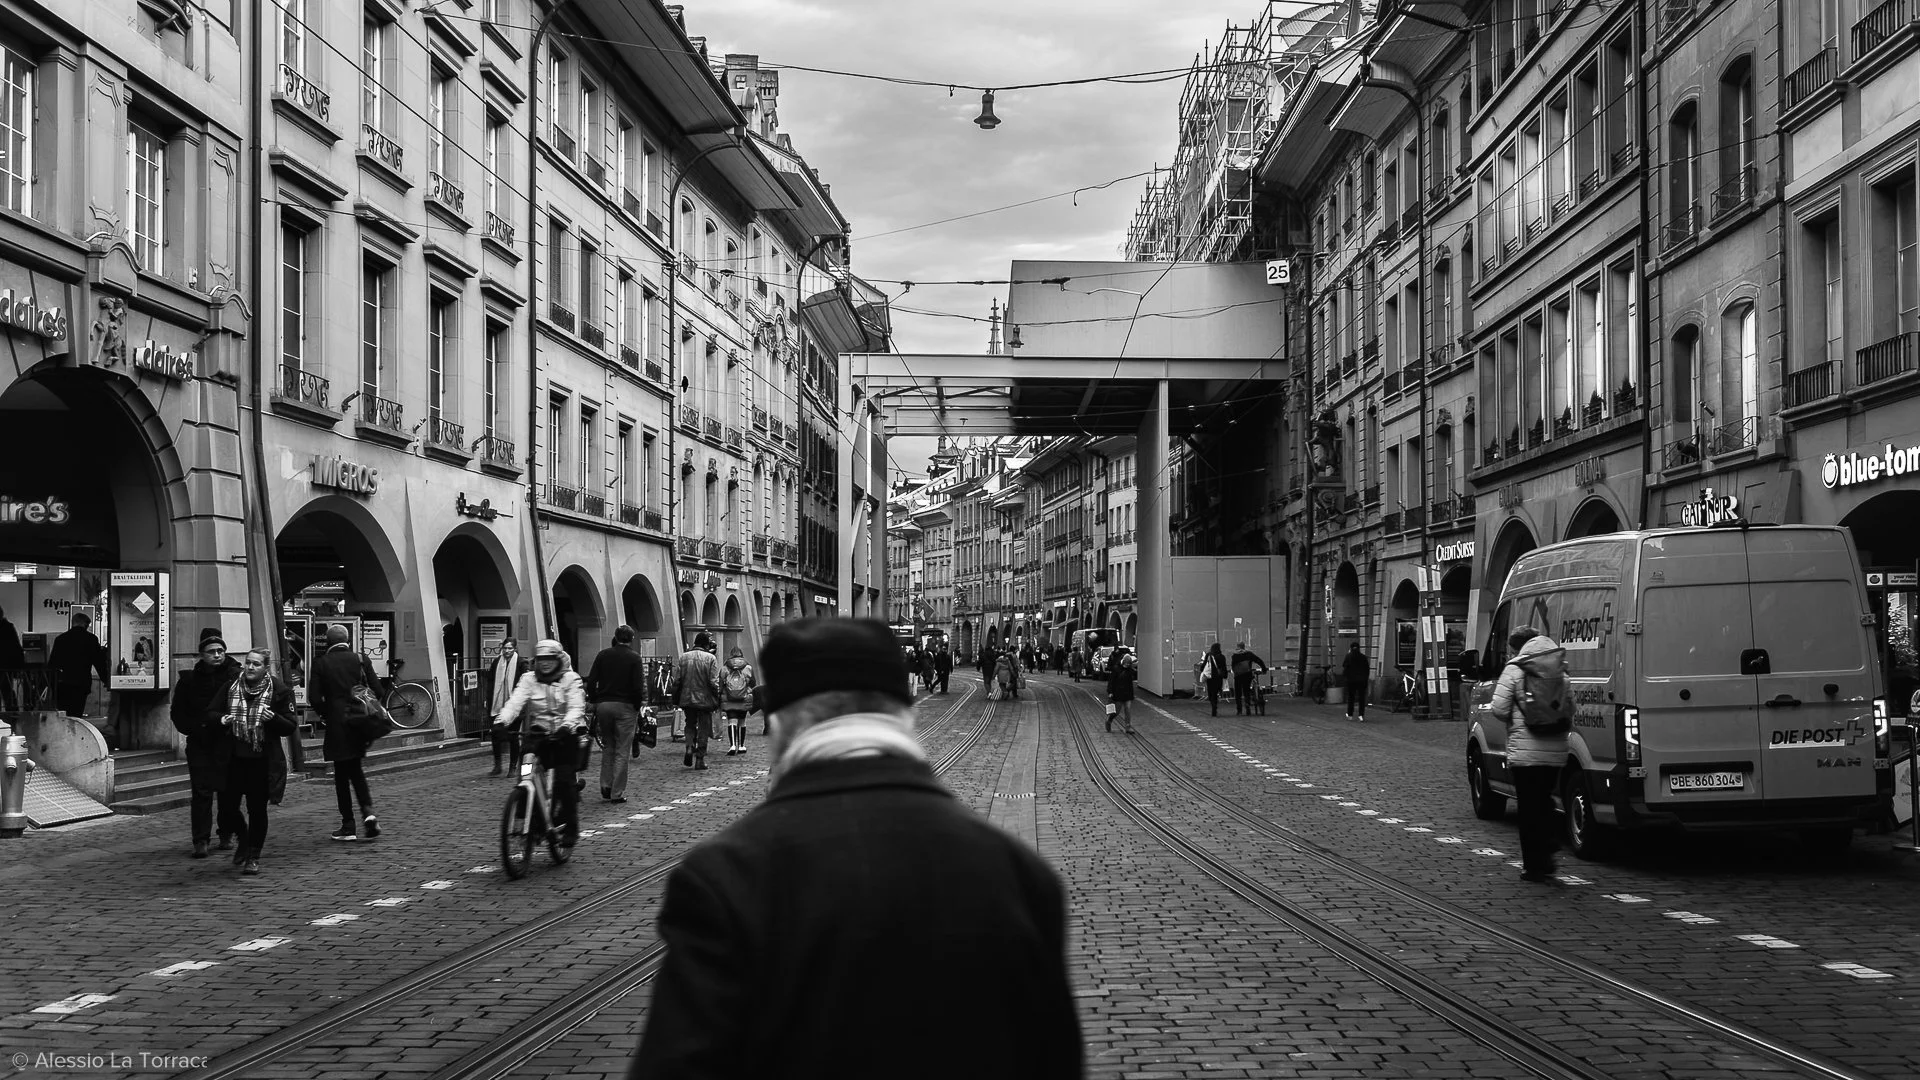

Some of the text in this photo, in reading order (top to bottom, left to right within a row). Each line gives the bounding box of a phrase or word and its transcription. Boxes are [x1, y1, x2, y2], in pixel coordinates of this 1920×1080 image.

[1267, 266, 1289, 280] 25
[0, 289, 67, 341] claire's
[136, 340, 194, 382] claire's
[313, 455, 378, 496] MIGROS
[1436, 544, 1457, 563] CREDIT
[1561, 617, 1600, 643] DIE POST
[1772, 728, 1845, 745] DIE POST
[1817, 757, 1862, 768] MAN
